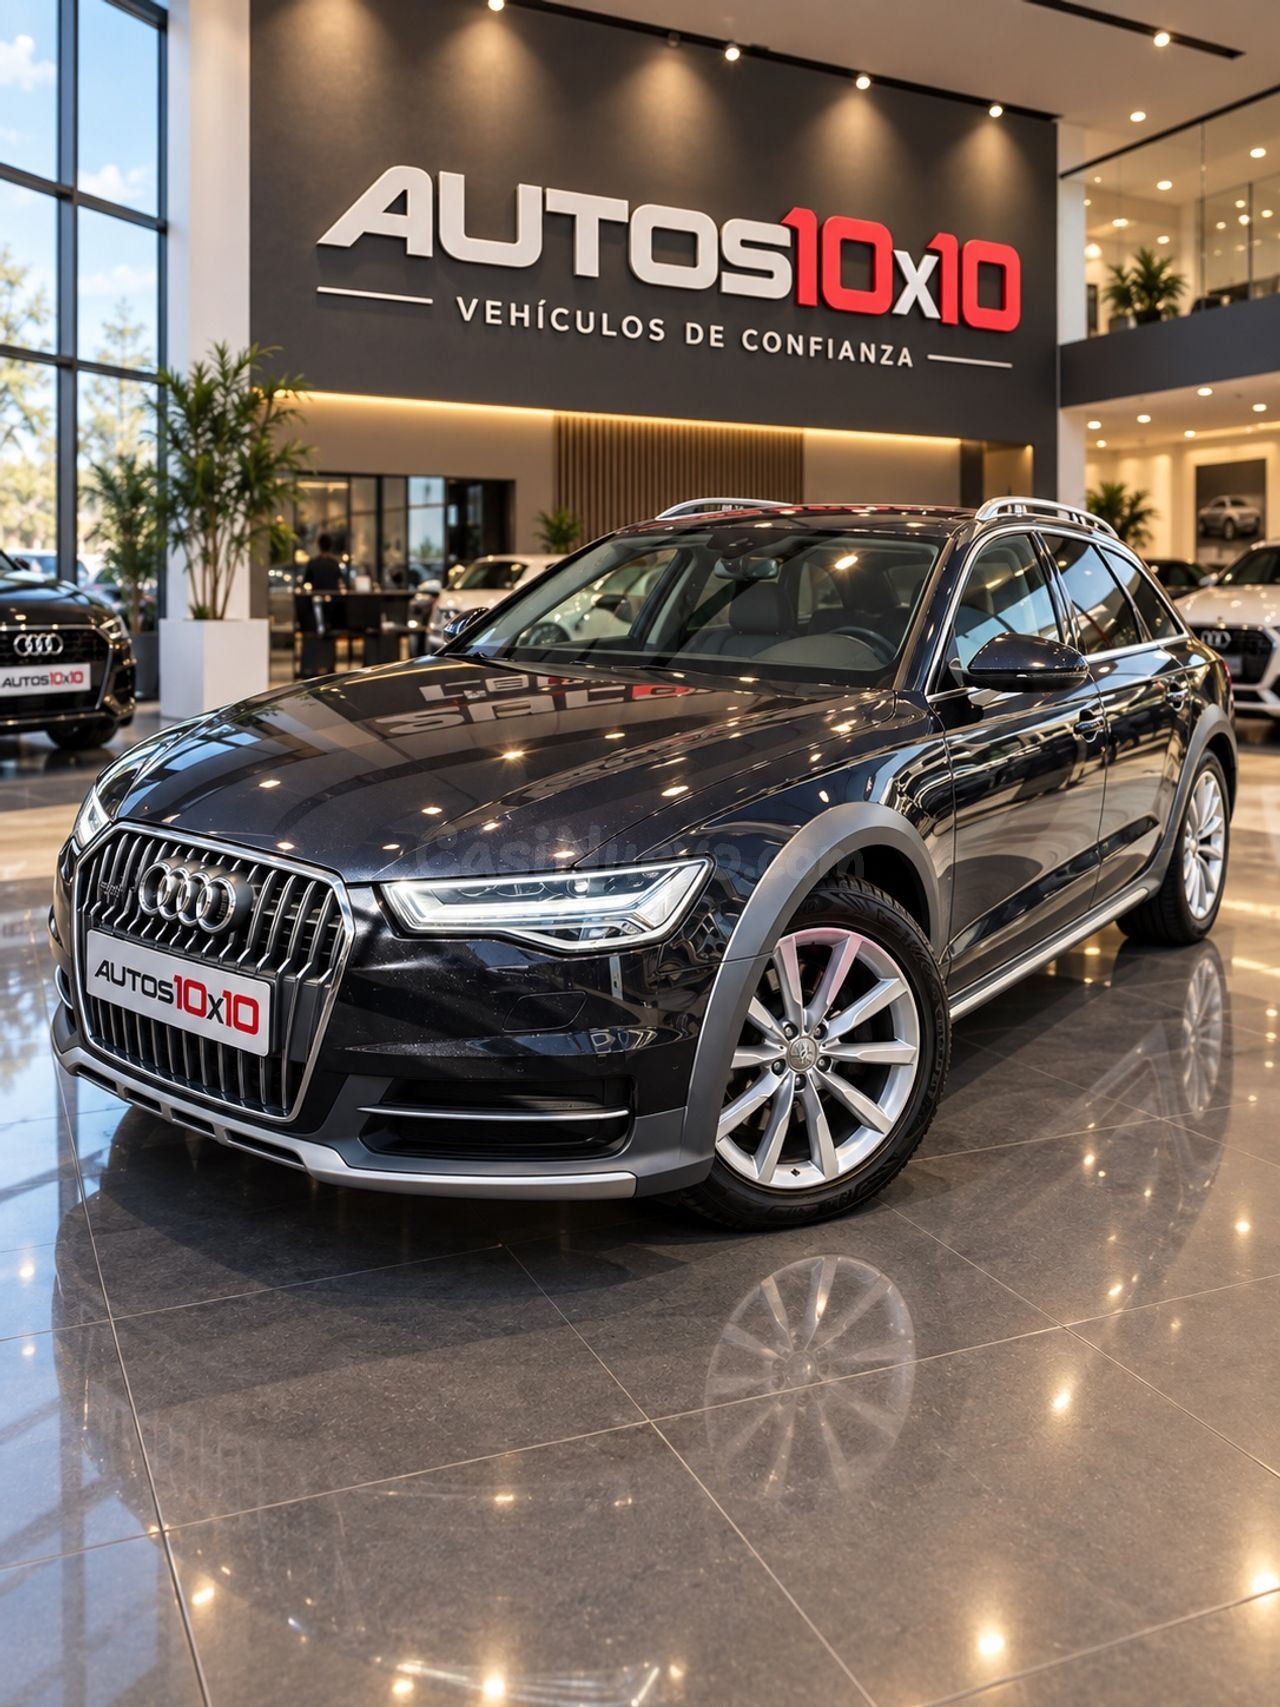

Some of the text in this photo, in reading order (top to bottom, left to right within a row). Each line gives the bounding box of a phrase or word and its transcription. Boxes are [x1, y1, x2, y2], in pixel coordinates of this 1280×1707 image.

[456, 296, 913, 368] VEHÍCULOS DE CONFIANZA
